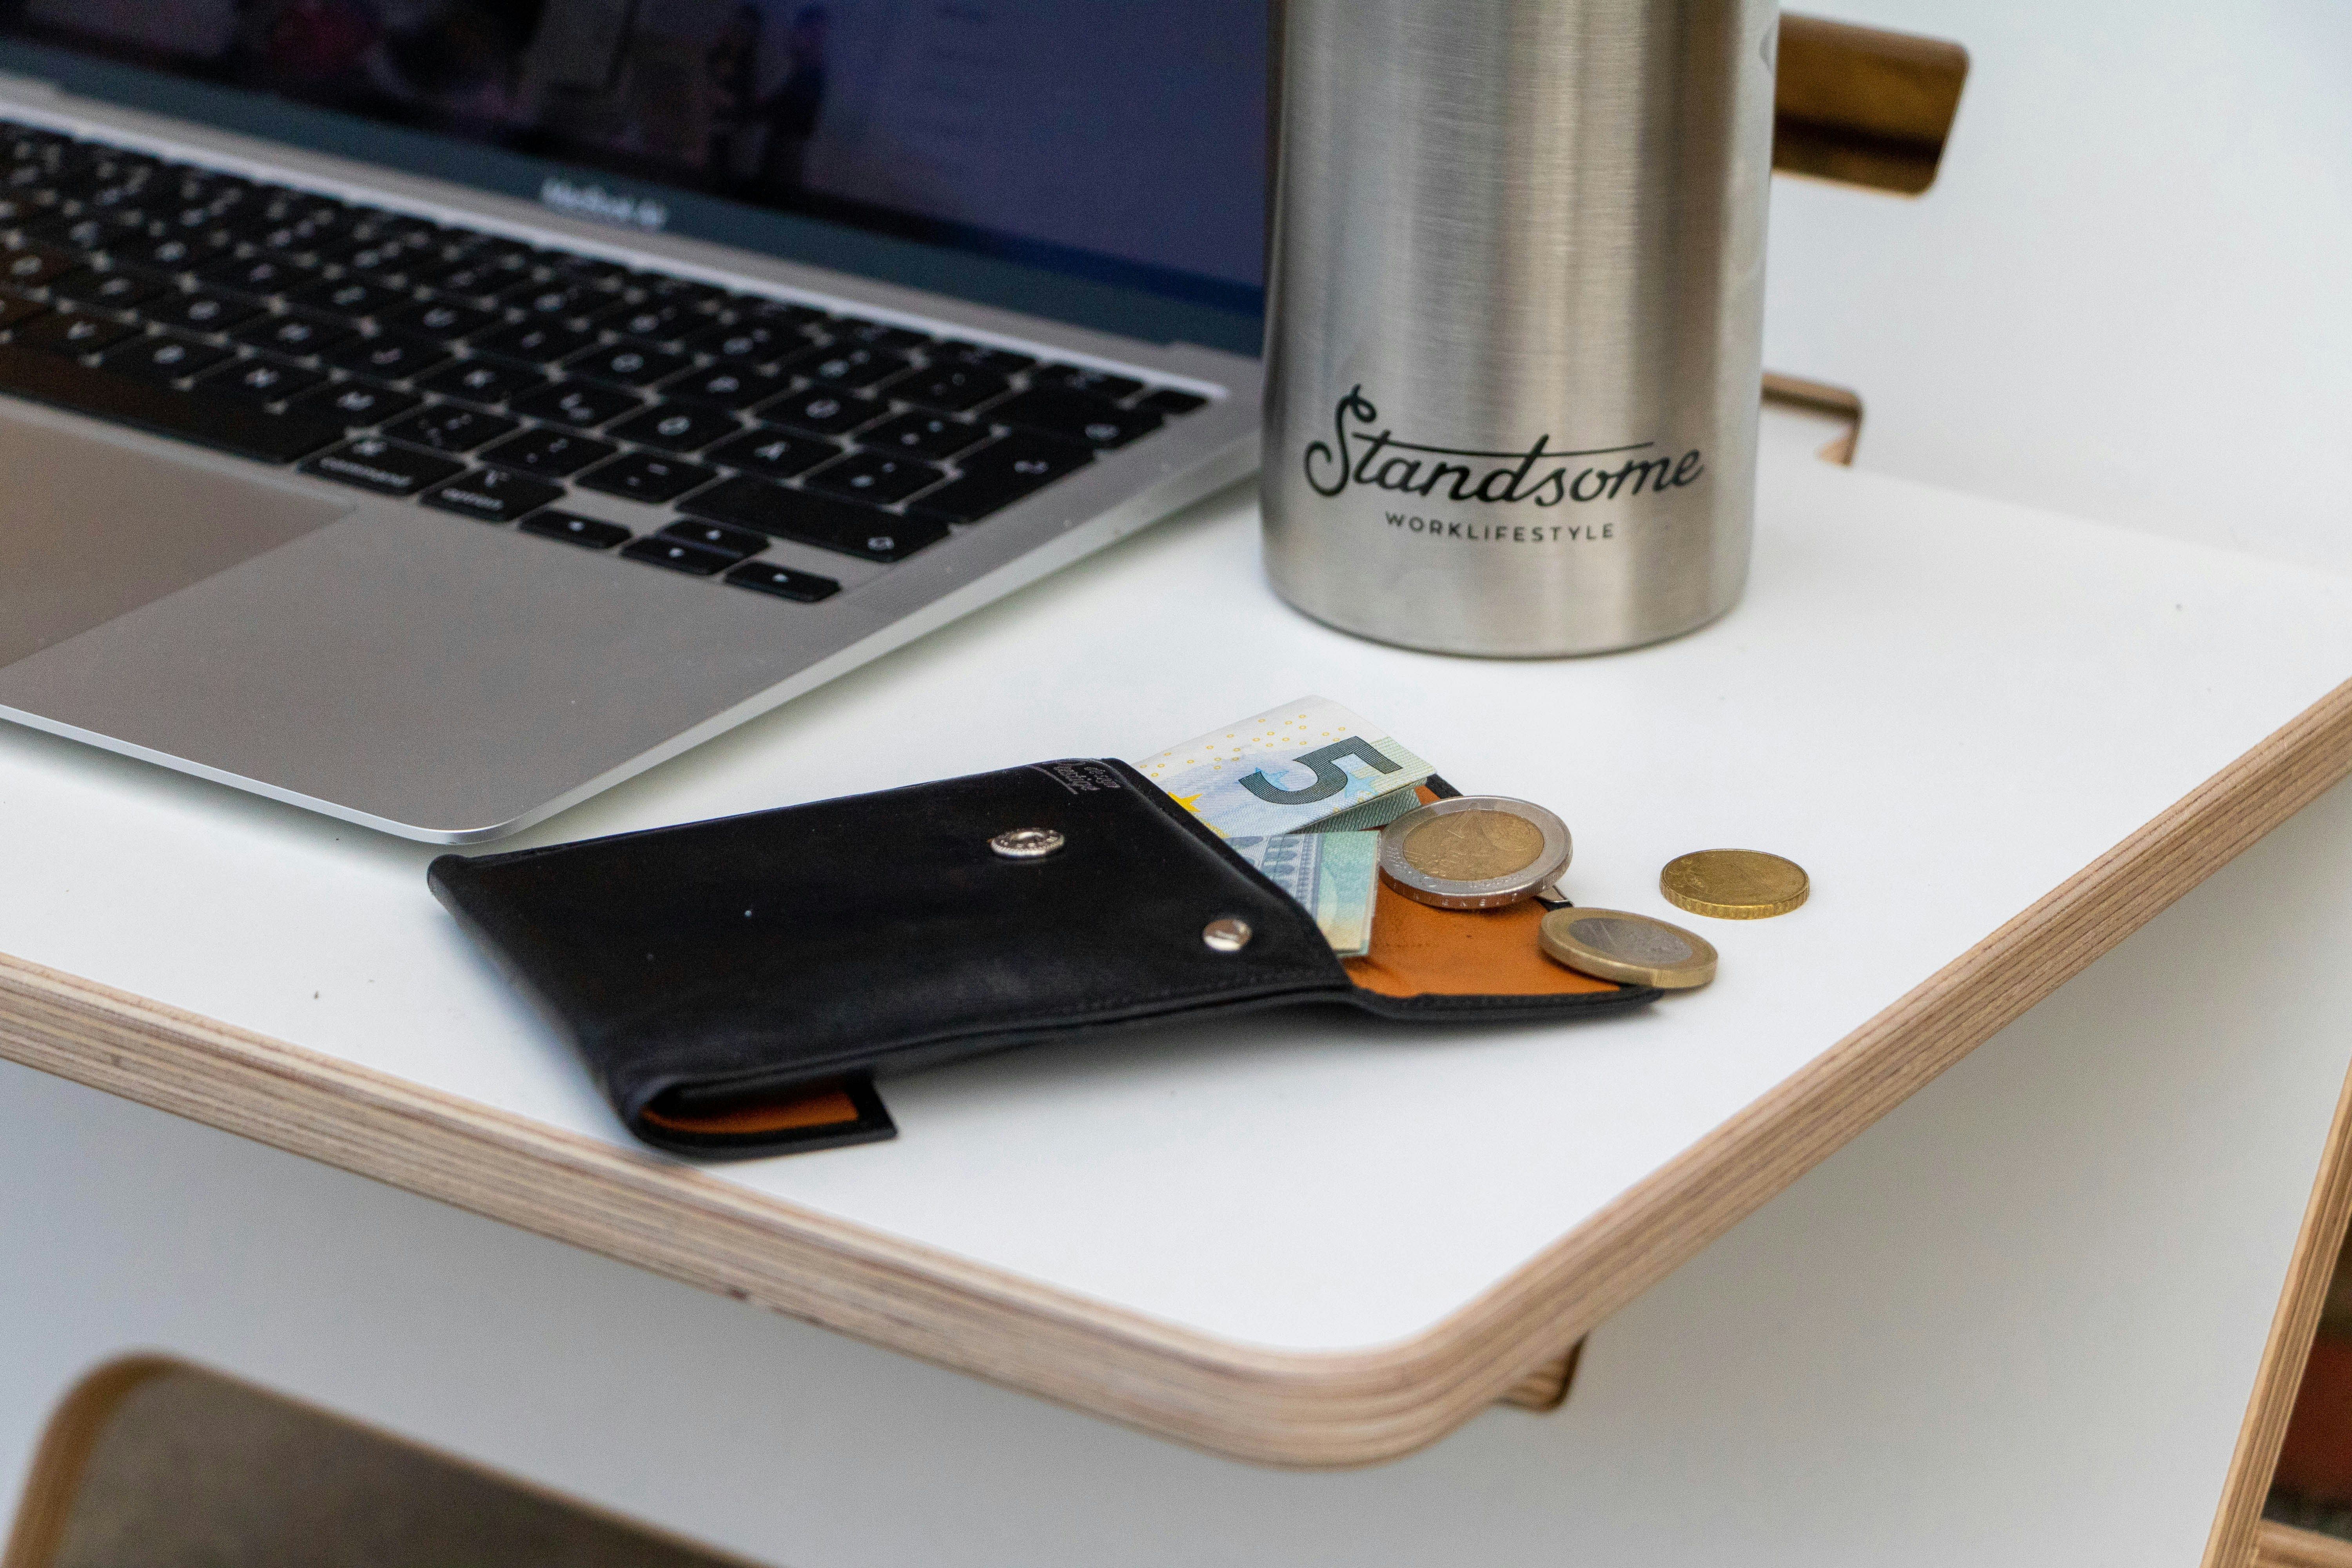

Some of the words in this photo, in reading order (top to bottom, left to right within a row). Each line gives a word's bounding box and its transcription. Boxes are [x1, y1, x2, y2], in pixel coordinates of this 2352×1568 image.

[1305, 385, 1704, 506] Standsome
[1385, 512, 1614, 542] WORKLIFESTYLE
[1238, 736, 1403, 805] 5
